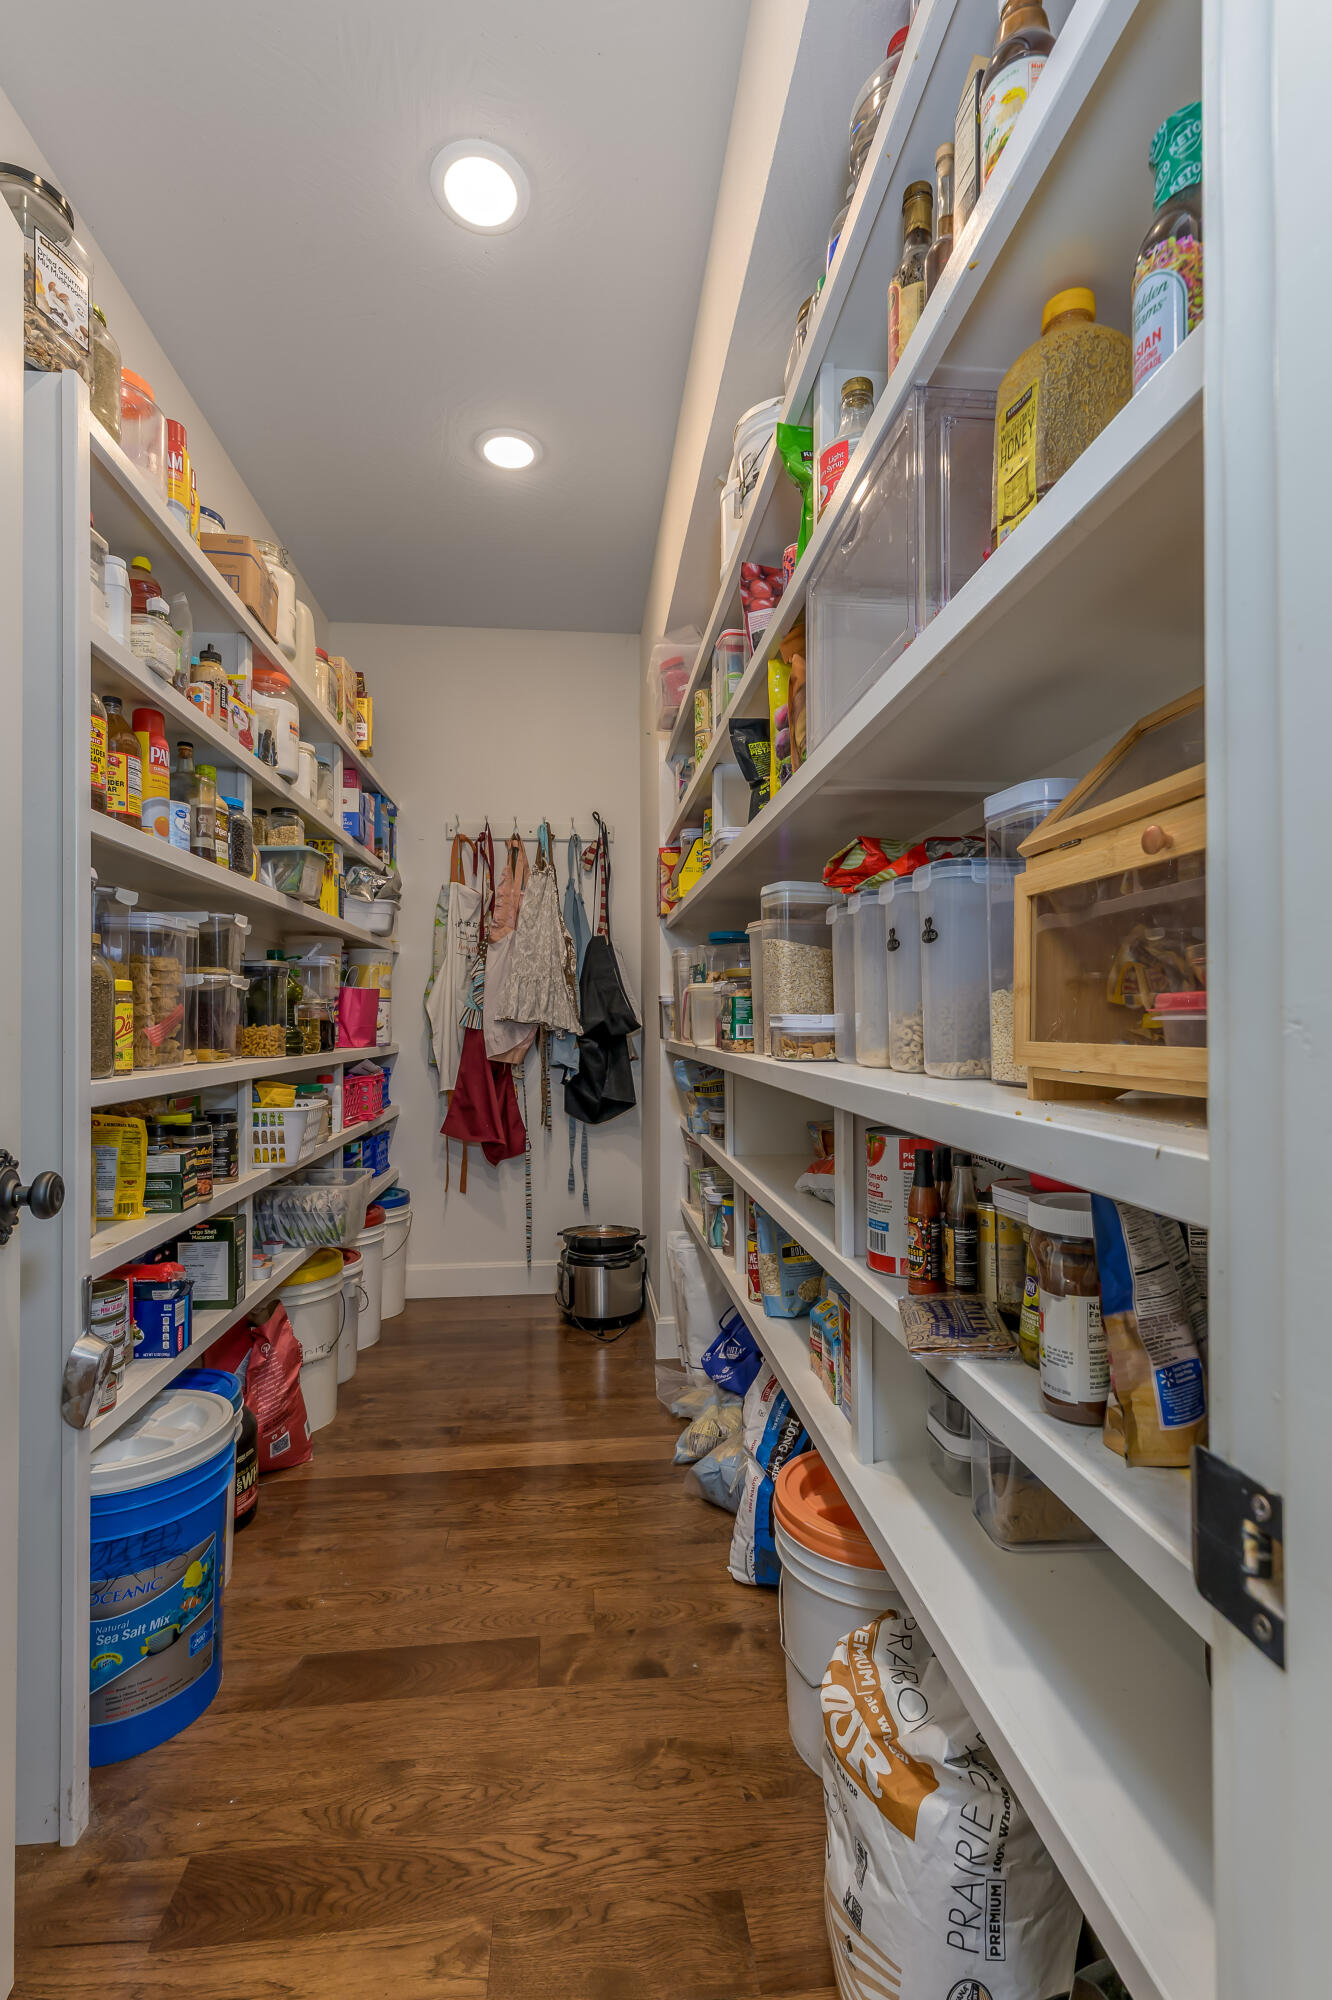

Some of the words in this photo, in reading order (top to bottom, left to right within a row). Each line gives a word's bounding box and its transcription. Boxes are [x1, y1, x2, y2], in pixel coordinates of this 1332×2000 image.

[1169, 121, 1201, 156] KETO
[1169, 162, 1201, 195] KETO
[37, 246, 57, 269] Dried
[37, 254, 49, 270] Mix
[1134, 326, 1162, 360] SIAN
[1000, 400, 1036, 445] WILDFLOWER
[828, 451, 845, 465] Light
[1000, 416, 1034, 468] HONEY
[168, 451, 183, 473] AM
[826, 460, 845, 474] Syrup
[778, 1419, 800, 1453] LONG
[750, 1475, 759, 1500] GLUTEN
[90, 1577, 161, 1607] OCEANIC
[95, 1619, 130, 1634] Natural
[95, 1632, 119, 1646] Sea
[121, 1623, 146, 1641] Salt
[149, 1615, 170, 1631] Mix
[836, 1764, 858, 1800] FLAVOR
[992, 1842, 1006, 1874] 100%
[999, 1786, 1011, 1838] Whole
[946, 1802, 995, 1954] PRAIRIE
[990, 1884, 1002, 1957] PREMIUM
